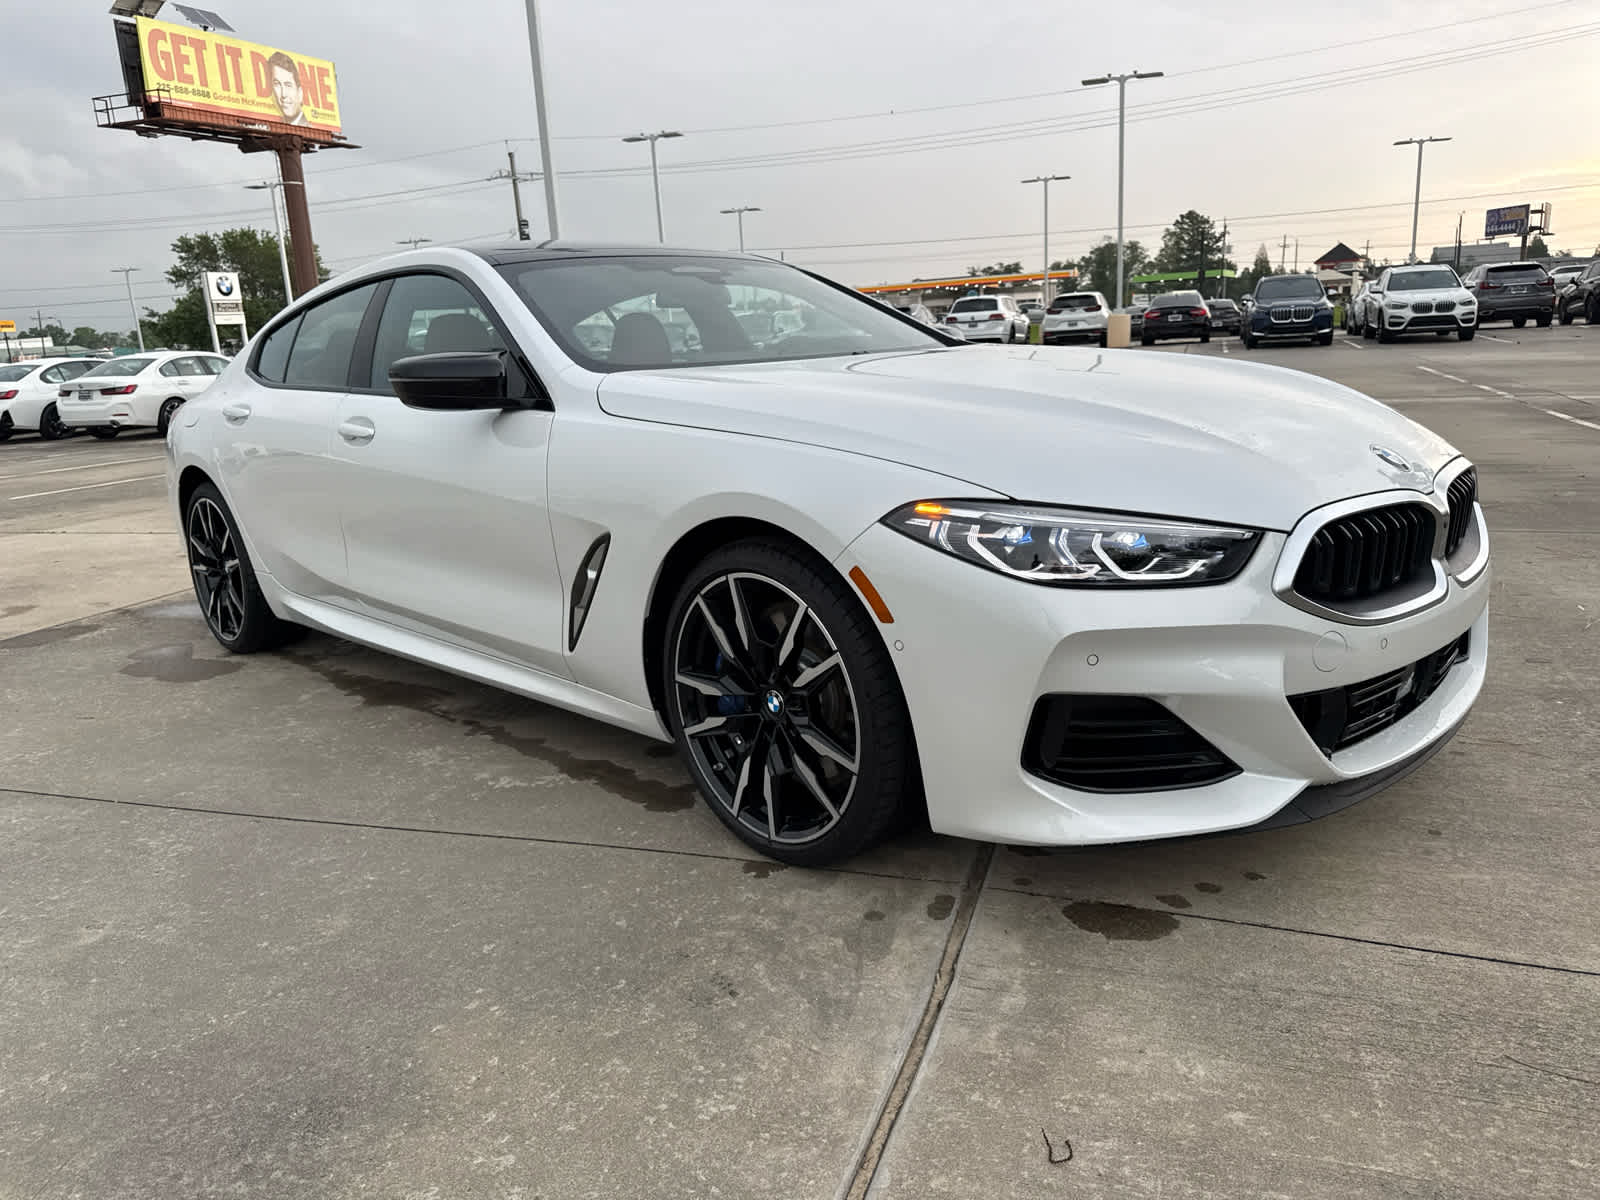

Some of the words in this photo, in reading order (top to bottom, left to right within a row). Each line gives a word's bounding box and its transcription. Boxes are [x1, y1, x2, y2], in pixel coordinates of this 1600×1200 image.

[147, 28, 209, 88] GET
[214, 42, 244, 94] IT
[213, 92, 241, 105] Gordon
